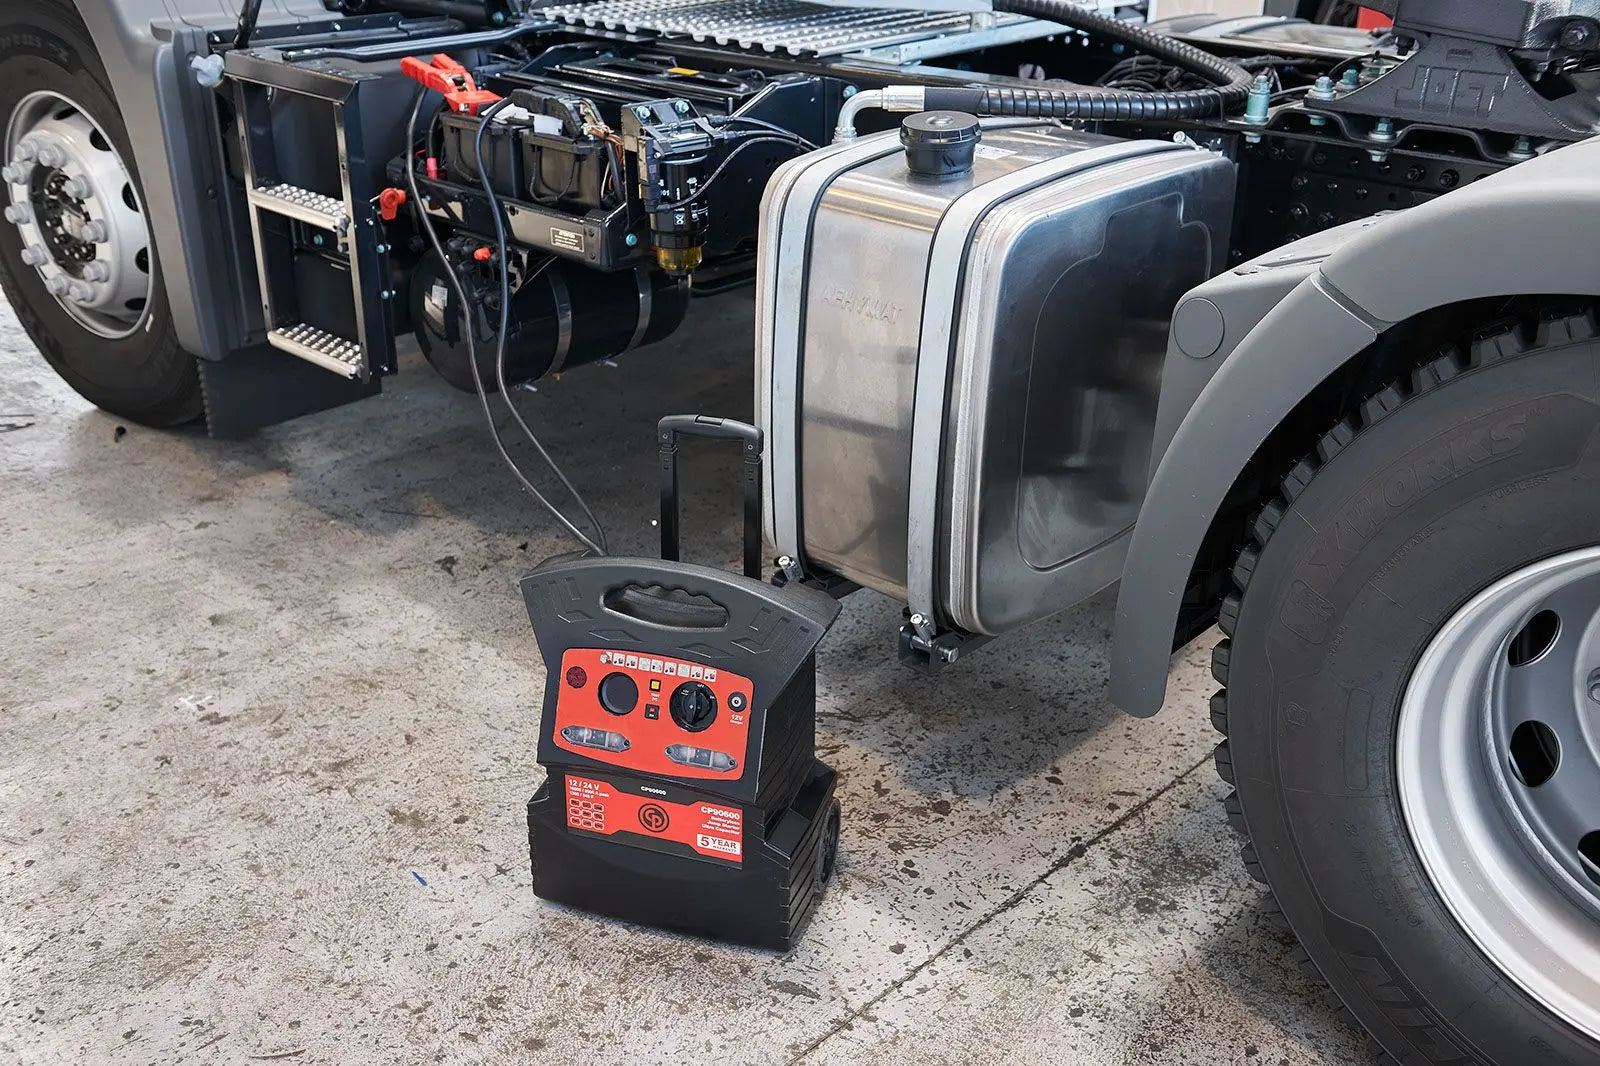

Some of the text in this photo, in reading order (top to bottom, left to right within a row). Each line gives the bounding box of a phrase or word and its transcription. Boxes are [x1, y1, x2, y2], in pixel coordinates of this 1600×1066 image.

[568, 779, 578, 787] 12
[583, 782, 593, 790] 24
[640, 785, 667, 796] CP90600
[700, 805, 740, 820] CP90600
[700, 836, 737, 849] 5 YEAR
